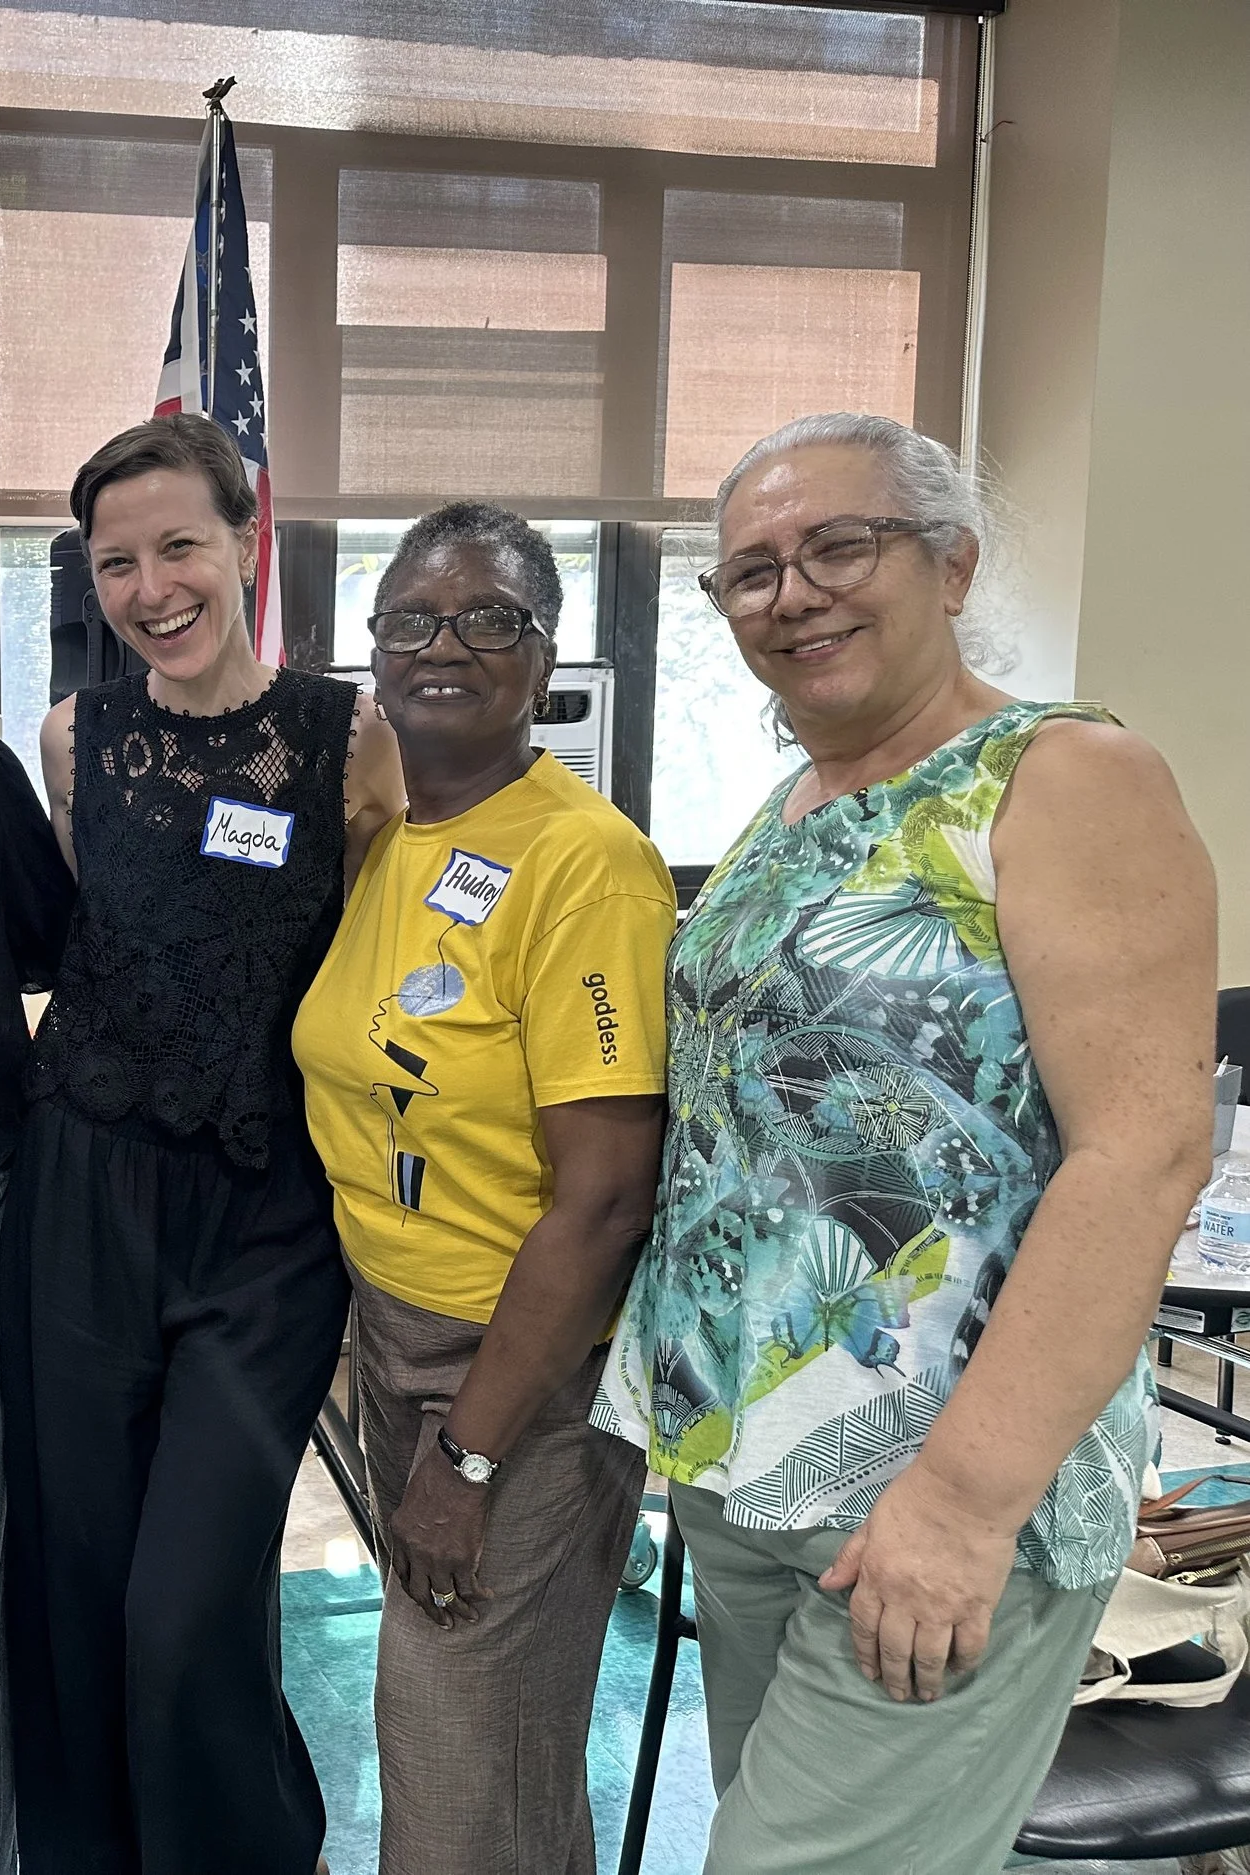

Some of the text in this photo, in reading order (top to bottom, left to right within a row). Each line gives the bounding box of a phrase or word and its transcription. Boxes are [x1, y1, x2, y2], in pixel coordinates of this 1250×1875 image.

[210, 812, 281, 857] Magda
[445, 862, 502, 912] Audrey
[582, 973, 619, 1065] goddess
[1204, 1220, 1234, 1237] WATER
